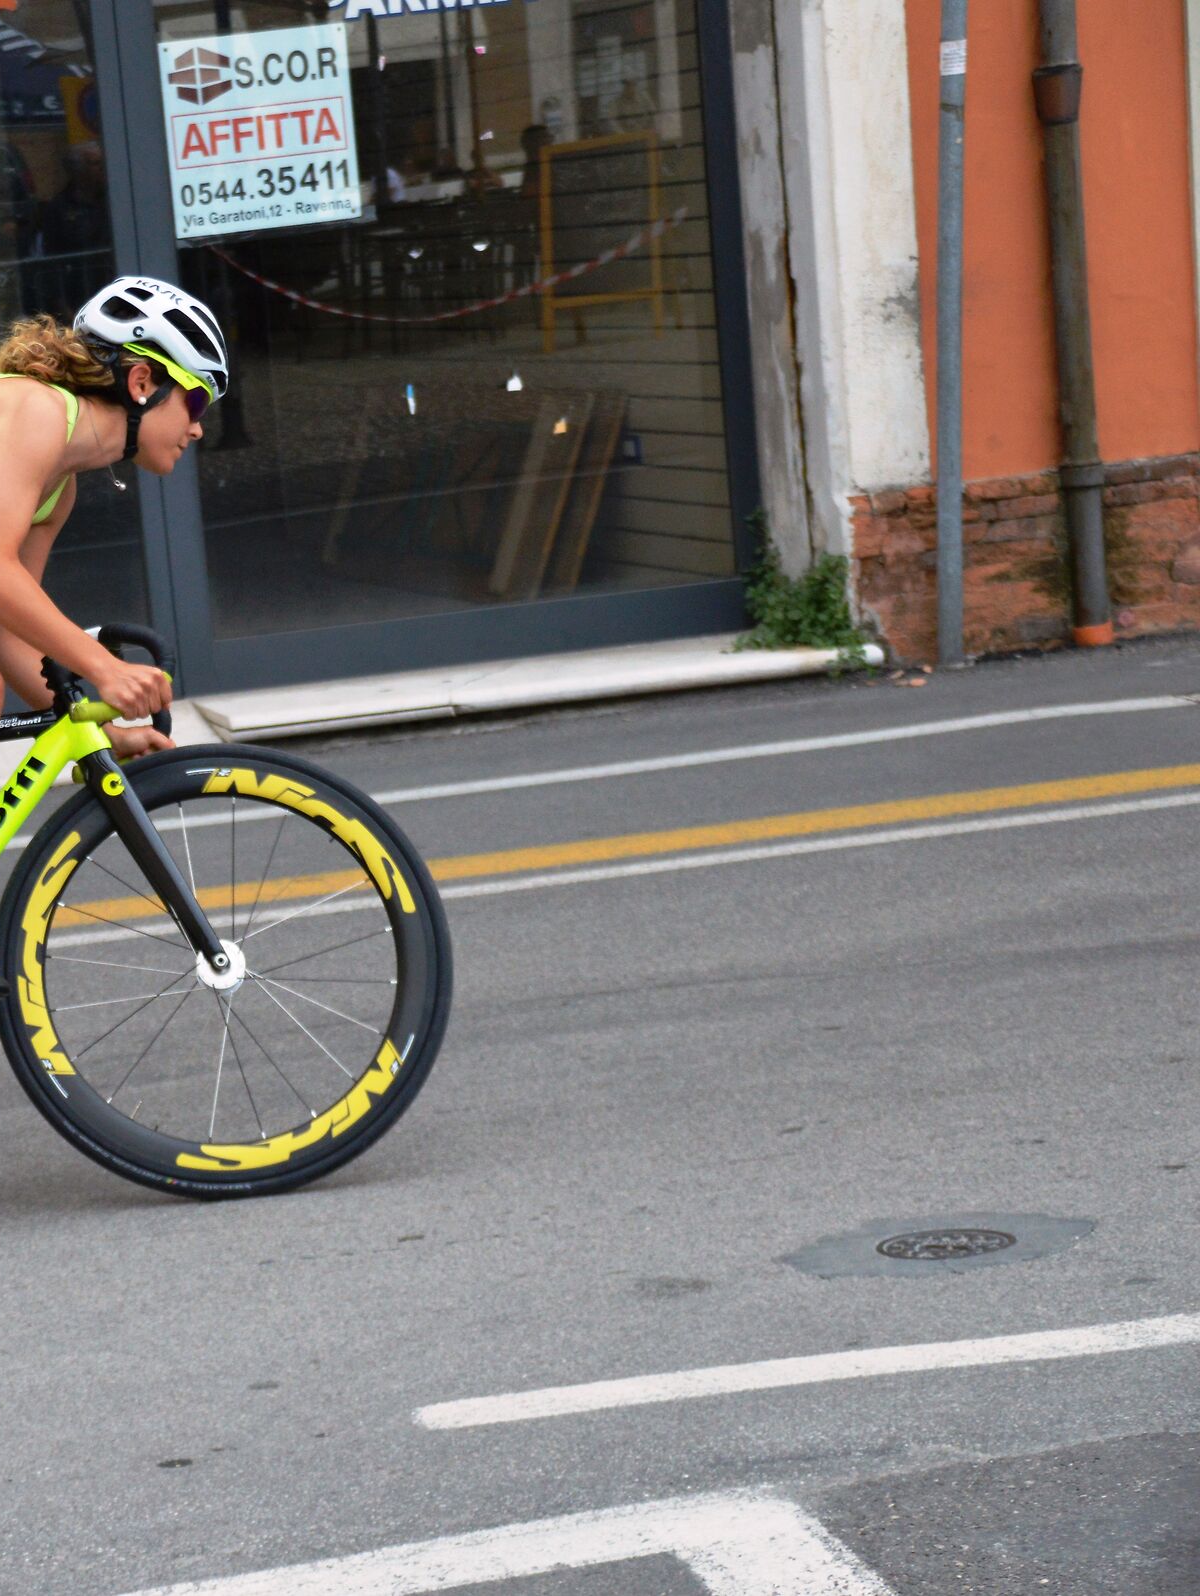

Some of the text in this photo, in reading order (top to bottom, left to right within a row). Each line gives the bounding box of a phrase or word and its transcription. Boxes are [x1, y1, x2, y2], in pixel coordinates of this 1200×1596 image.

[233, 47, 339, 90] S.CO.R
[181, 107, 341, 160] AFFITTA
[180, 159, 350, 208] 0544.35411
[183, 213, 205, 229] Via
[295, 198, 352, 216] Ravenna
